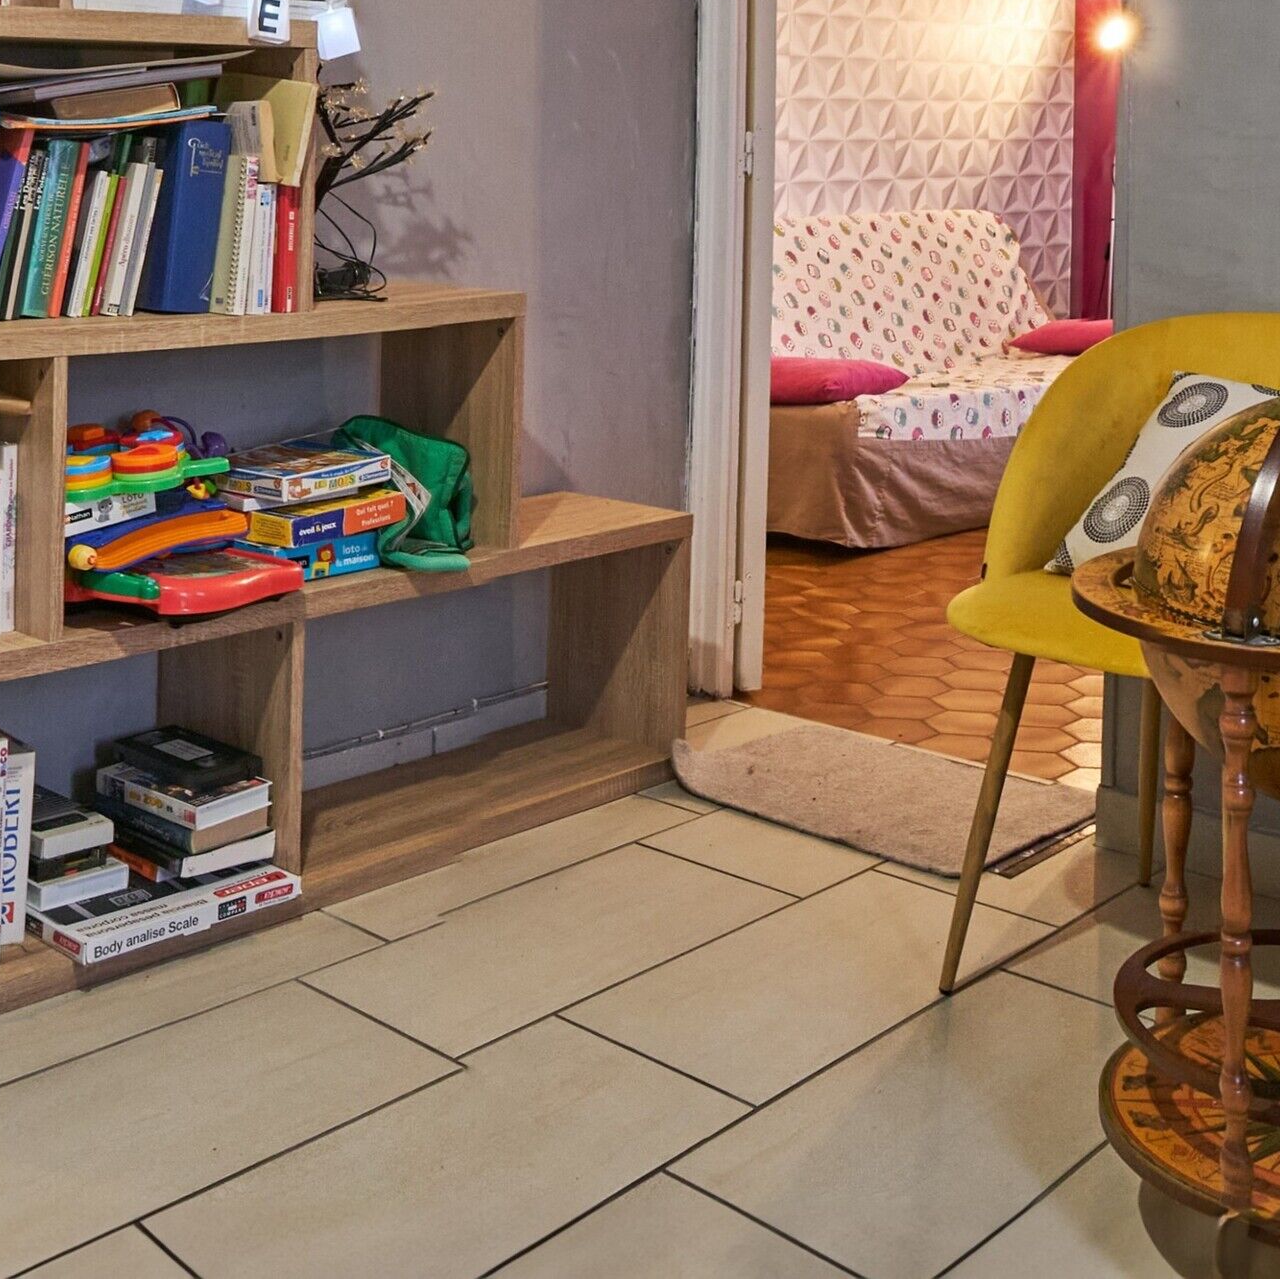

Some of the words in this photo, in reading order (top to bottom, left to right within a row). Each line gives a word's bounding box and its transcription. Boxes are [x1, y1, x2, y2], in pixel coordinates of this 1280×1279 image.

[19, 195, 27, 209] Les
[118, 245, 127, 265] Apéro
[40, 235, 56, 294] GUÉRISON
[122, 493, 144, 503] LOTO
[356, 507, 366, 516] Qui
[367, 504, 376, 513] fait
[362, 514, 391, 527] Professions
[299, 526, 315, 536] éveil
[321, 521, 336, 532] jeux
[343, 544, 360, 553] loto
[343, 553, 374, 566] maison
[94, 938, 123, 959] Body
[126, 927, 166, 948] analise
[169, 915, 200, 934] Scale
